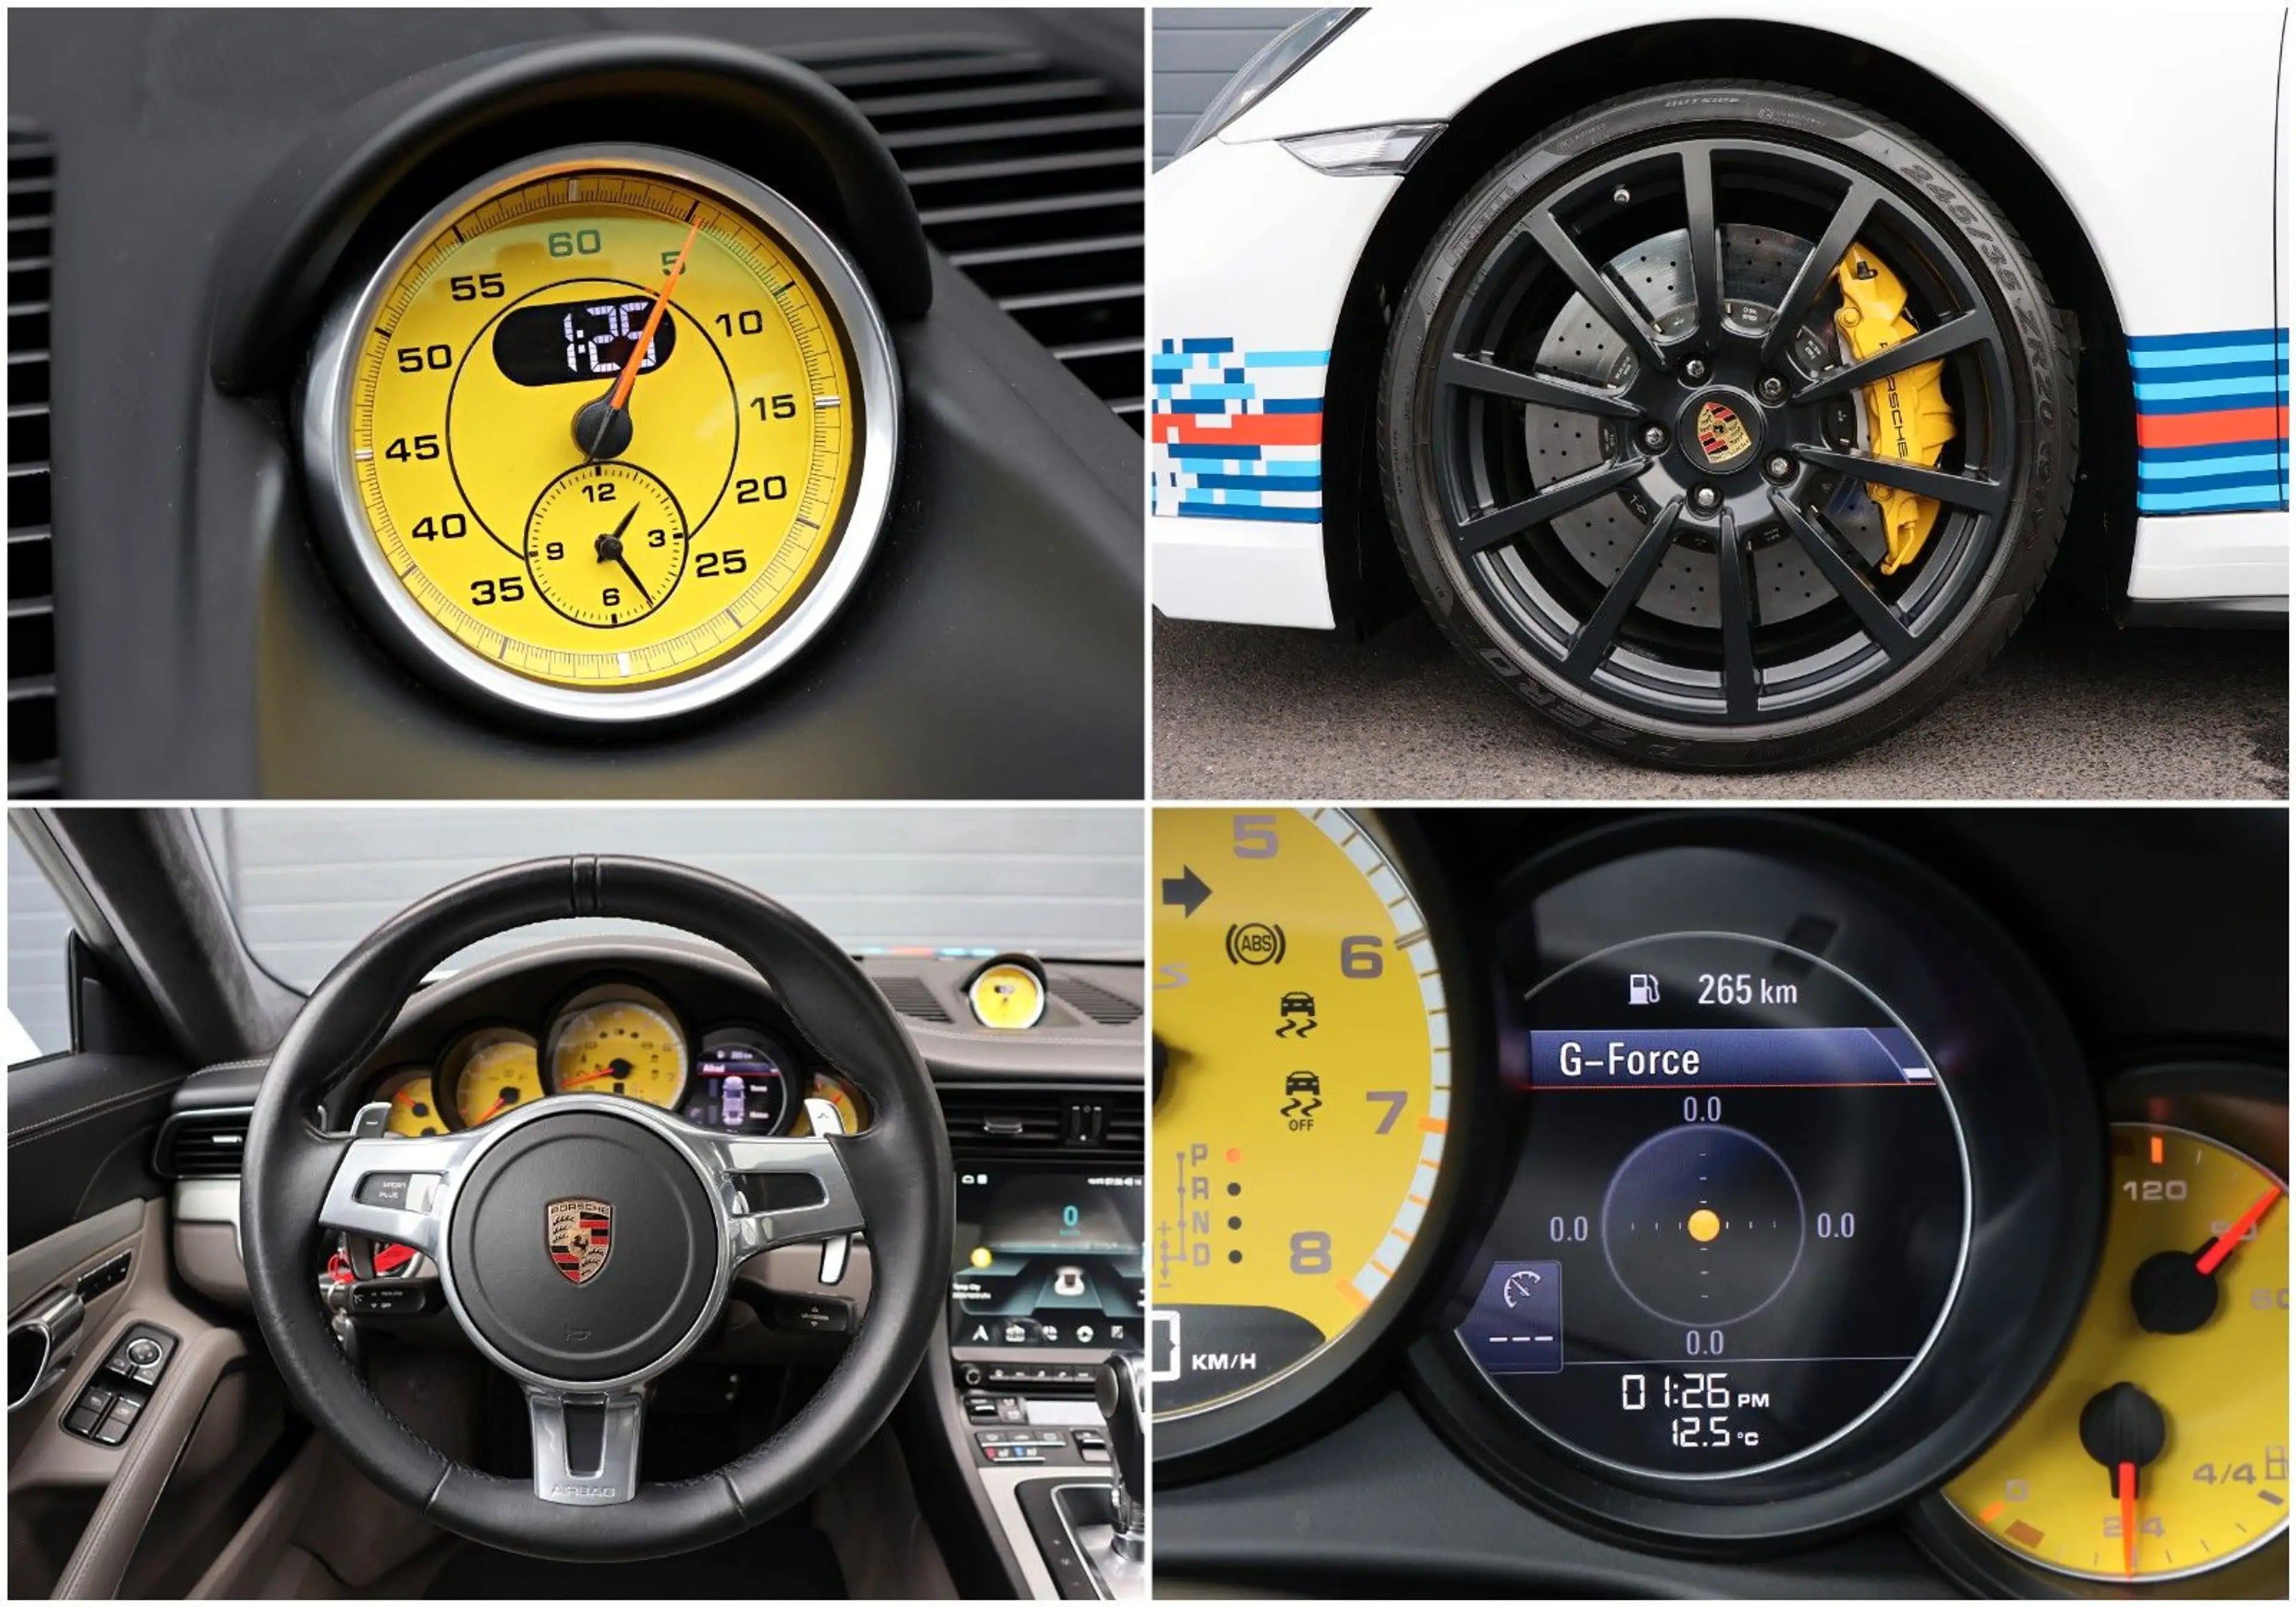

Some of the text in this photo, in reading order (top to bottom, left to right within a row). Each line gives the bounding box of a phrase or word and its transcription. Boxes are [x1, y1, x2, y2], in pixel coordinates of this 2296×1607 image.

[548, 230, 602, 258] 60
[661, 251, 686, 276] 5
[450, 273, 505, 301] 55
[563, 301, 657, 373] 1:25
[716, 310, 763, 338] 10
[398, 344, 452, 372] 50
[750, 394, 796, 421] 15
[1879, 341, 1908, 459] PRSCHE
[386, 435, 440, 462] 45
[582, 482, 616, 503] 12
[736, 475, 787, 504] 20
[411, 512, 467, 541] 40
[647, 529, 665, 548] 3
[546, 542, 564, 561] 9
[695, 549, 747, 578] 25
[471, 576, 524, 606] 35
[602, 588, 620, 607] 6
[1232, 814, 1279, 860] 5
[1241, 935, 1272, 952] ABS
[1340, 935, 1384, 979] 6
[1697, 974, 1798, 1005] 265 km
[1559, 1041, 1700, 1077] G-Force
[1366, 1090, 1408, 1135] 7
[1684, 1096, 1721, 1122] 0.0
[1289, 1119, 1314, 1132] OFF
[1191, 1143, 1208, 1167] P
[1192, 1176, 1209, 1200] R
[2123, 1180, 2188, 1201] 120
[551, 1203, 610, 1214] PORSCHE
[1062, 1205, 1079, 1227] 0
[1192, 1210, 1210, 1235] N
[1550, 1216, 1589, 1242] 0.0
[1817, 1212, 1855, 1239] 0.0
[1193, 1242, 1211, 1267] D
[1290, 1231, 1332, 1275] 8
[1686, 1330, 1724, 1355] 0.0
[1192, 1353, 1256, 1371] KM/H
[1622, 1373, 1770, 1410] 01:26 PM
[1672, 1416, 1731, 1447] 12.5
[2191, 1462, 2257, 1486] 4/4
[2102, 1516, 2166, 1538] 24
